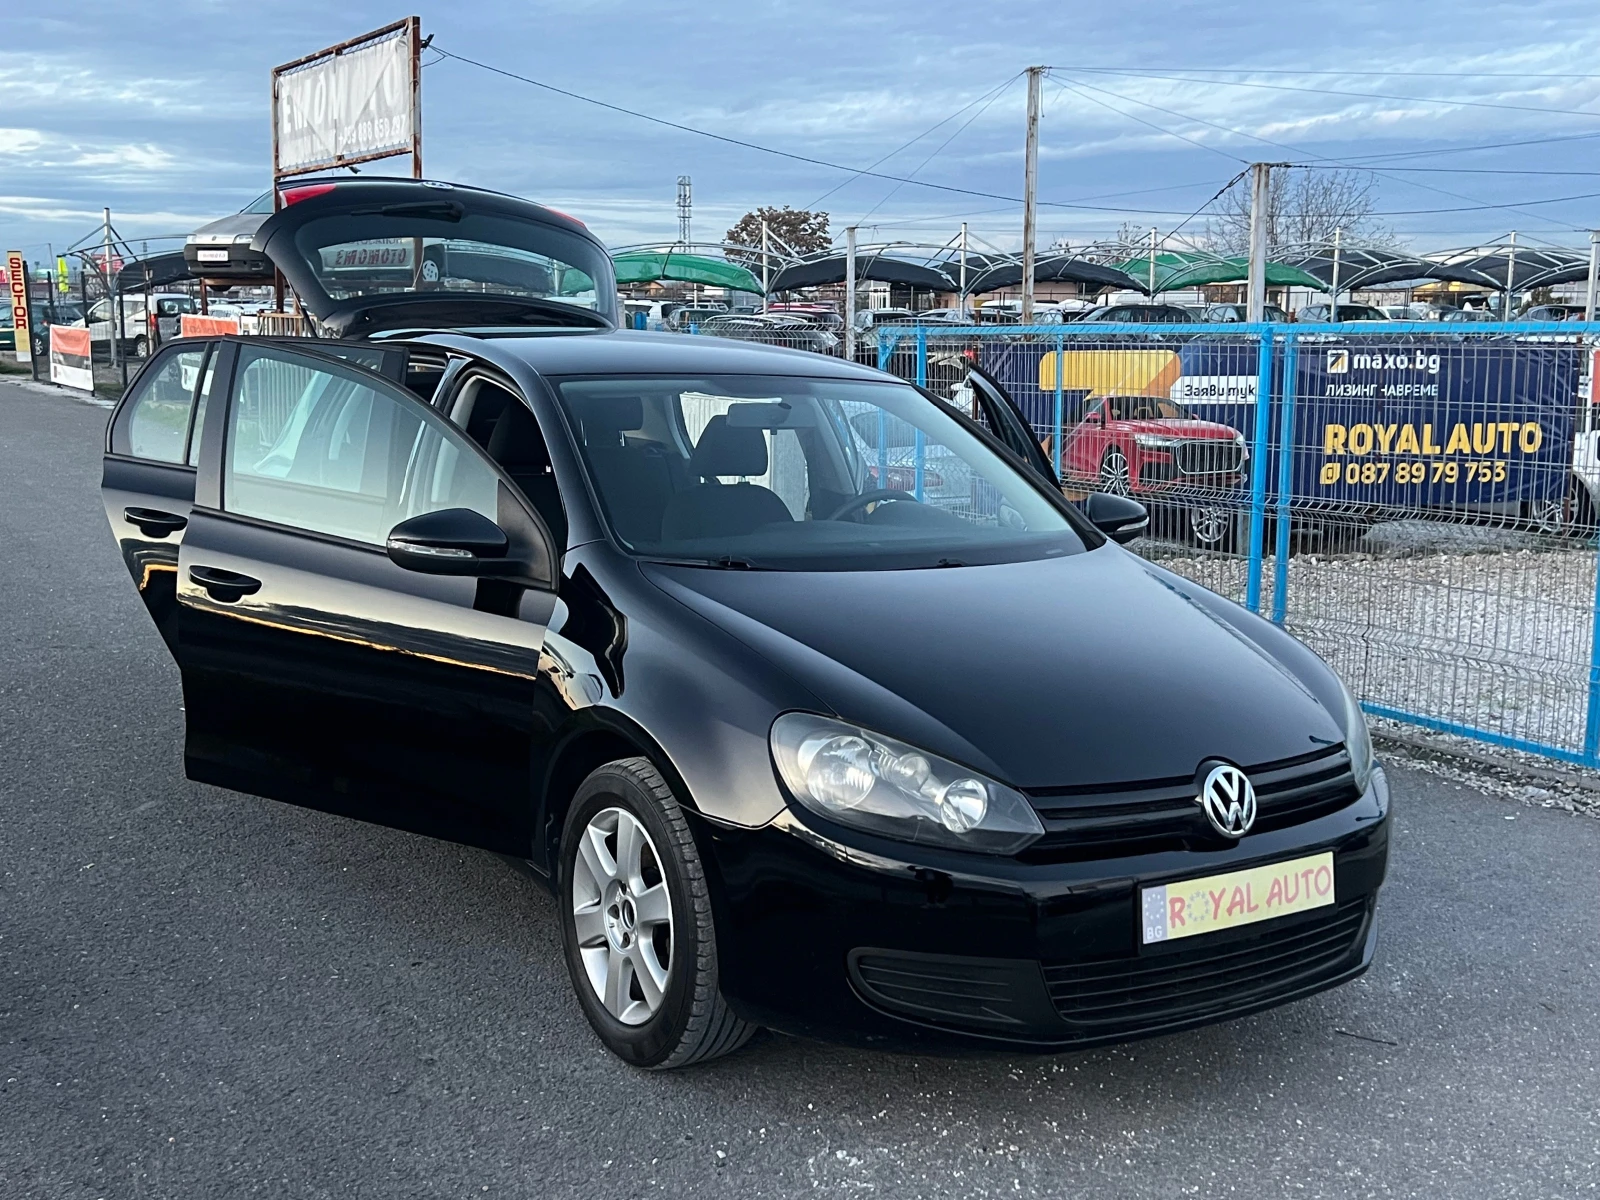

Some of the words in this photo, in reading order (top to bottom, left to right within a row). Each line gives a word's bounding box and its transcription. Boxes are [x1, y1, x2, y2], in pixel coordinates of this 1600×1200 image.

[9, 257, 28, 329] SECTOR
[1353, 349, 1441, 374] maxo.bg
[1325, 383, 1377, 397] ЛИЗИНГ
[1324, 422, 1441, 456] ROYAL
[1445, 421, 1543, 455] AUTO
[1345, 462, 1389, 485] 087
[1395, 462, 1425, 484] 89
[1431, 462, 1459, 484] 79
[1464, 461, 1506, 483] 753
[1265, 864, 1332, 908] AUTO
[1146, 925, 1163, 941] BG
